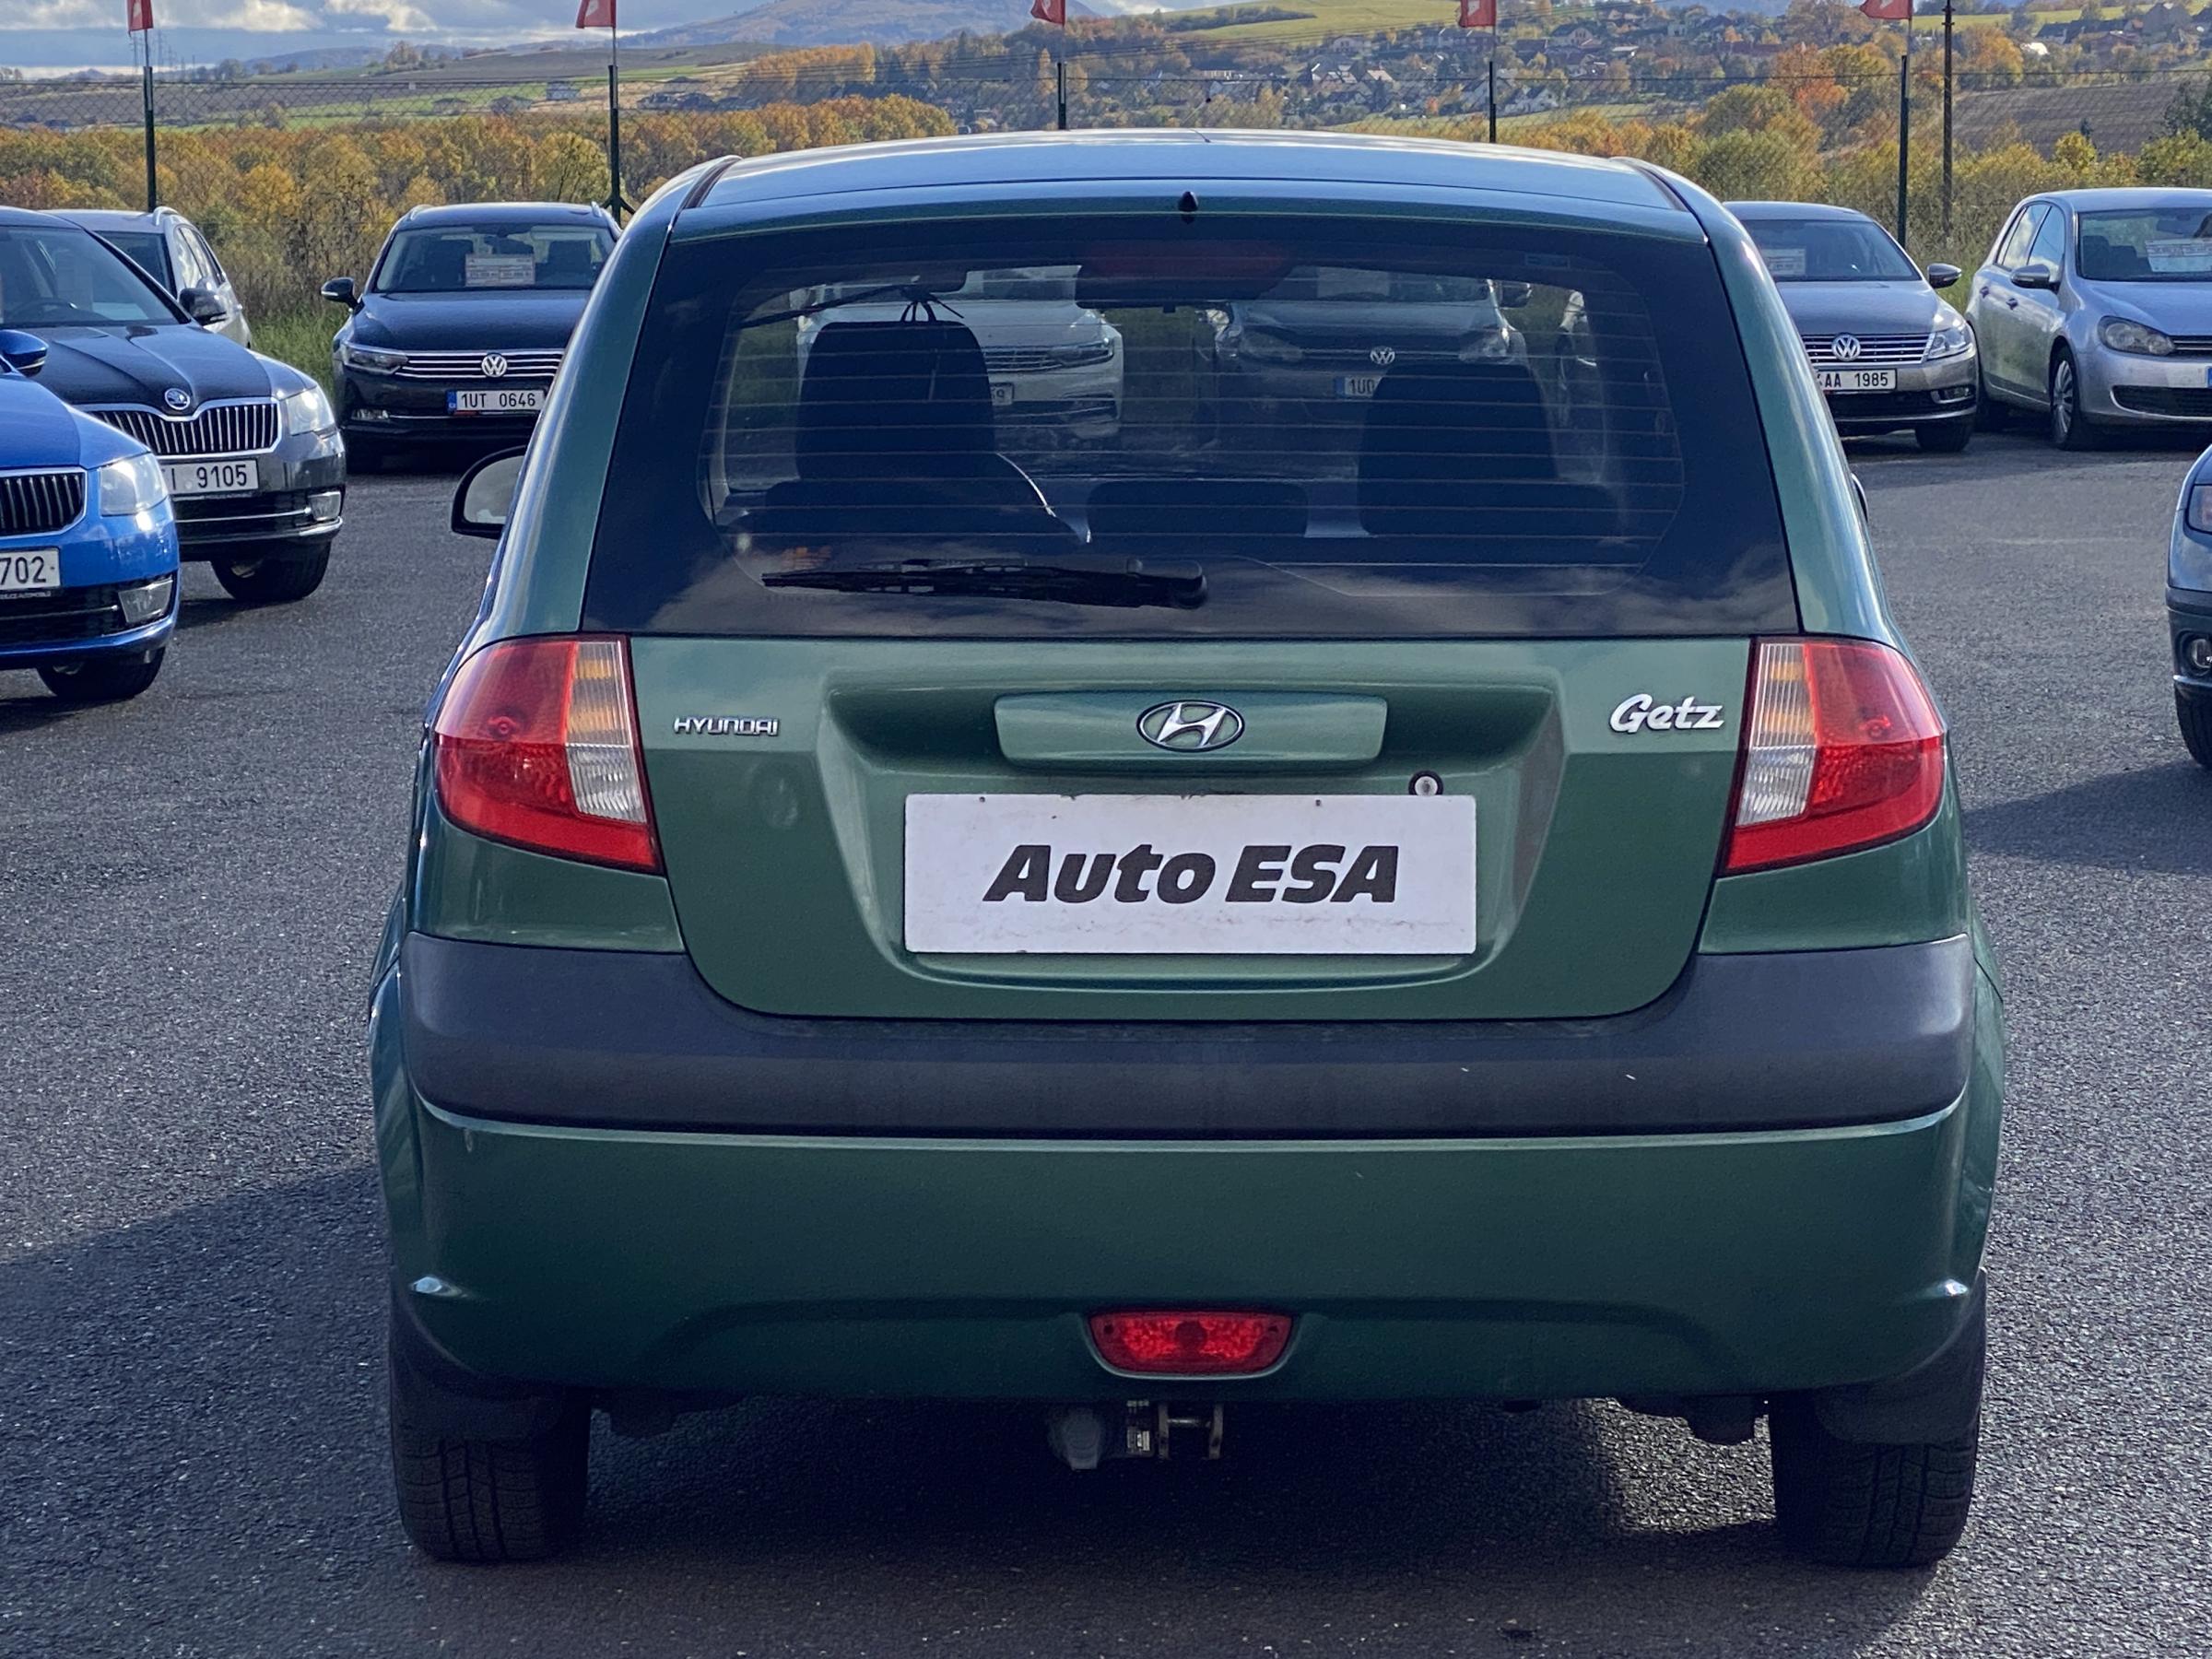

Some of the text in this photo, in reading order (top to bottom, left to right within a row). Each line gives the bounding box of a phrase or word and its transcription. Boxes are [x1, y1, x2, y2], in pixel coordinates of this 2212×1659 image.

[1854, 371, 1888, 387] 1985
[461, 393, 487, 408] 1UT
[499, 393, 536, 407] 0646
[196, 464, 248, 489] 9105
[0, 556, 47, 585] 702
[1609, 693, 1725, 734] Getz
[674, 717, 779, 736] HYUNDAI
[982, 843, 1399, 904] Auto ESA
